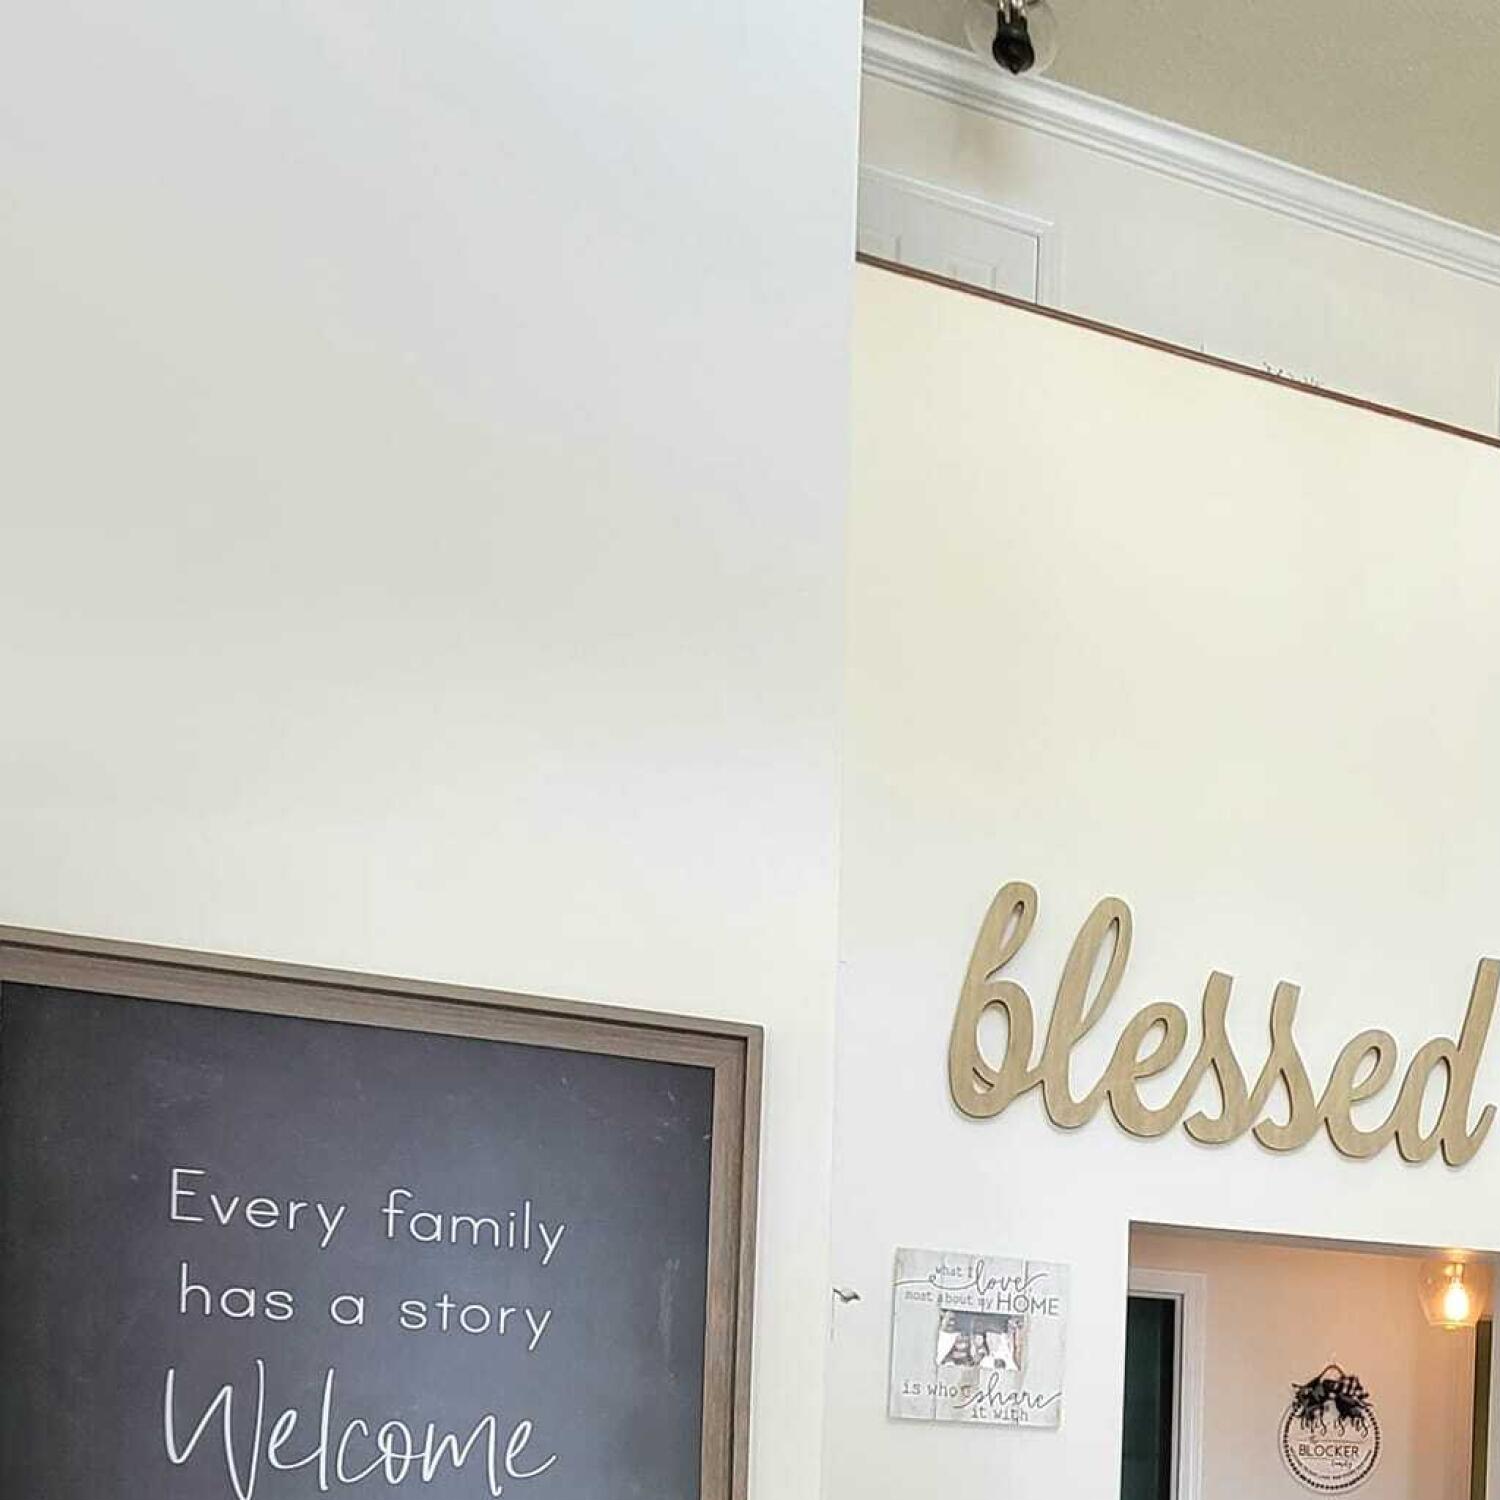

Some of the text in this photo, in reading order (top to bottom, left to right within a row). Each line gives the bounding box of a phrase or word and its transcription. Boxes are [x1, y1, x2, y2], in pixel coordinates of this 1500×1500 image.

[170, 1167, 566, 1266] Every family
[179, 1261, 552, 1351] has a story
[996, 1291, 1060, 1316] HOME
[1298, 1443, 1360, 1458] BLOCKER
